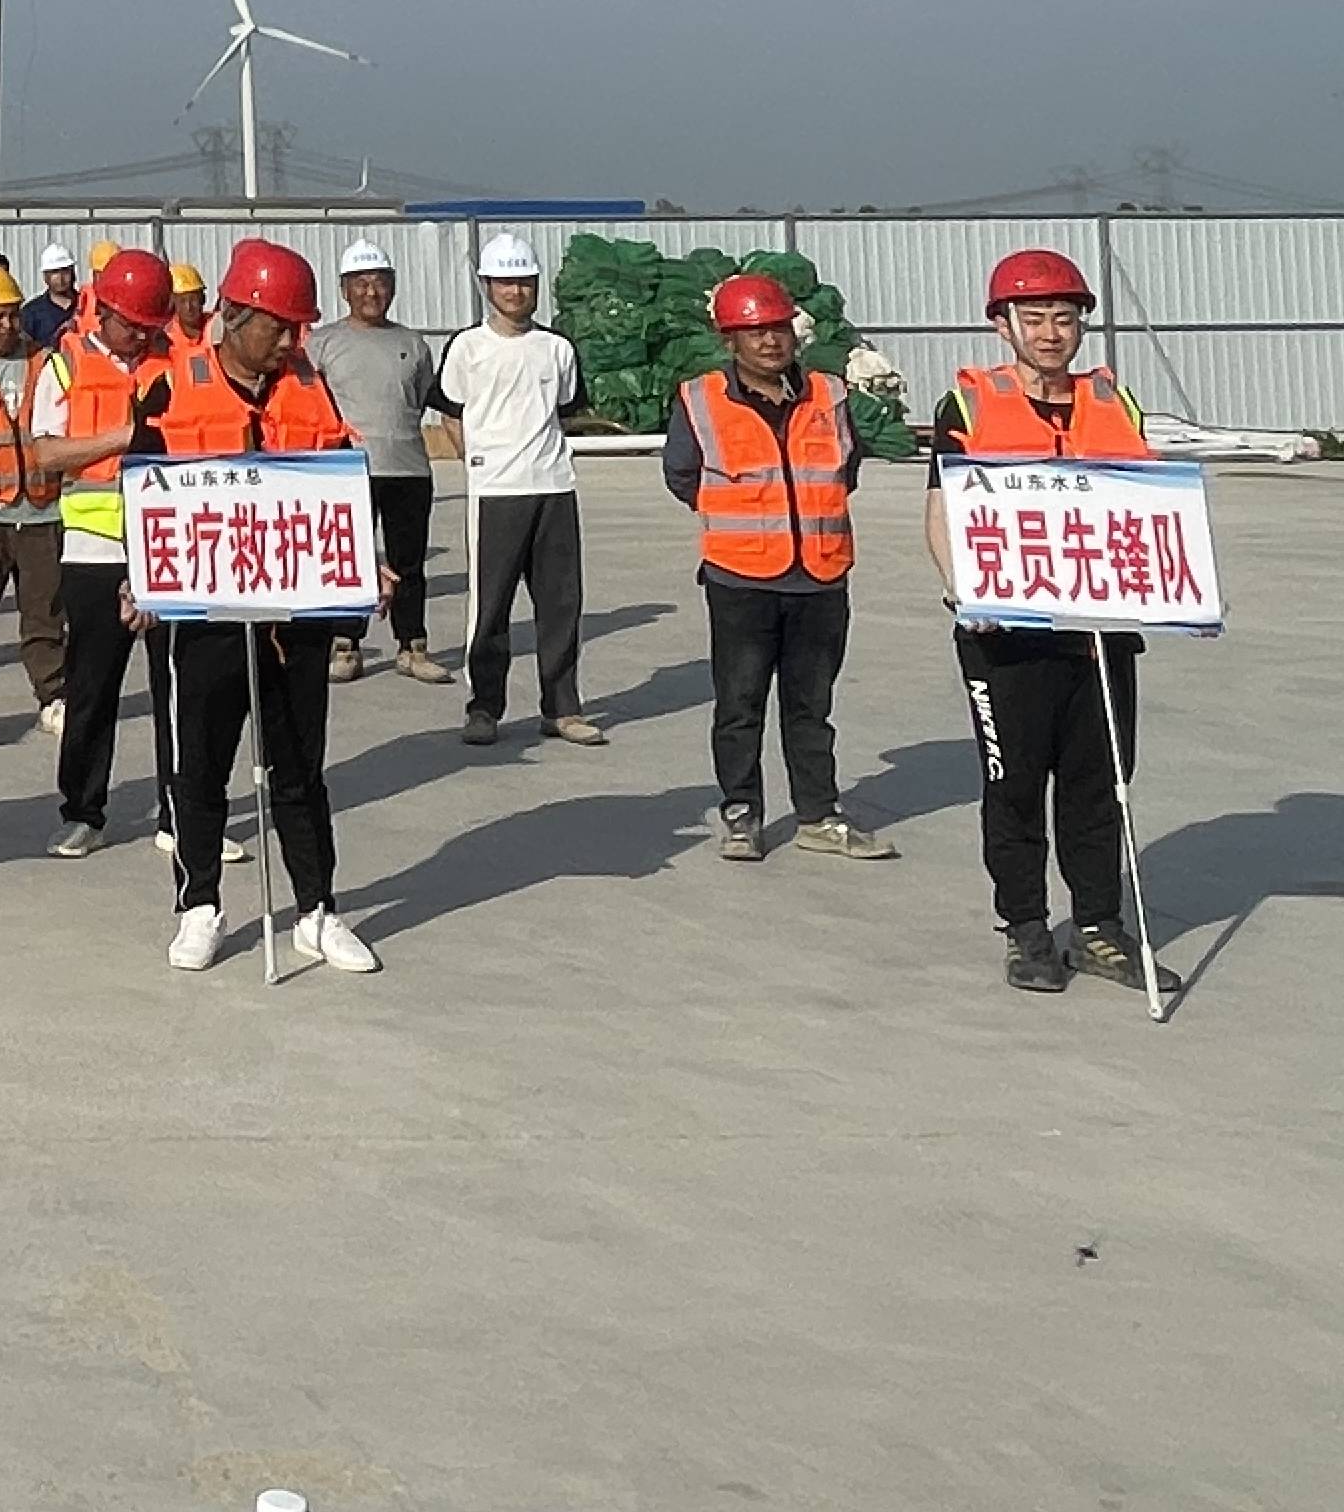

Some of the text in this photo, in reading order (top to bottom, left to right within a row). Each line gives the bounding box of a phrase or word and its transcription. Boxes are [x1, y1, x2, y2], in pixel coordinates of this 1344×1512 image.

[141, 499, 362, 594] 医疗救护组
[965, 505, 1202, 605] 党员先锋队
